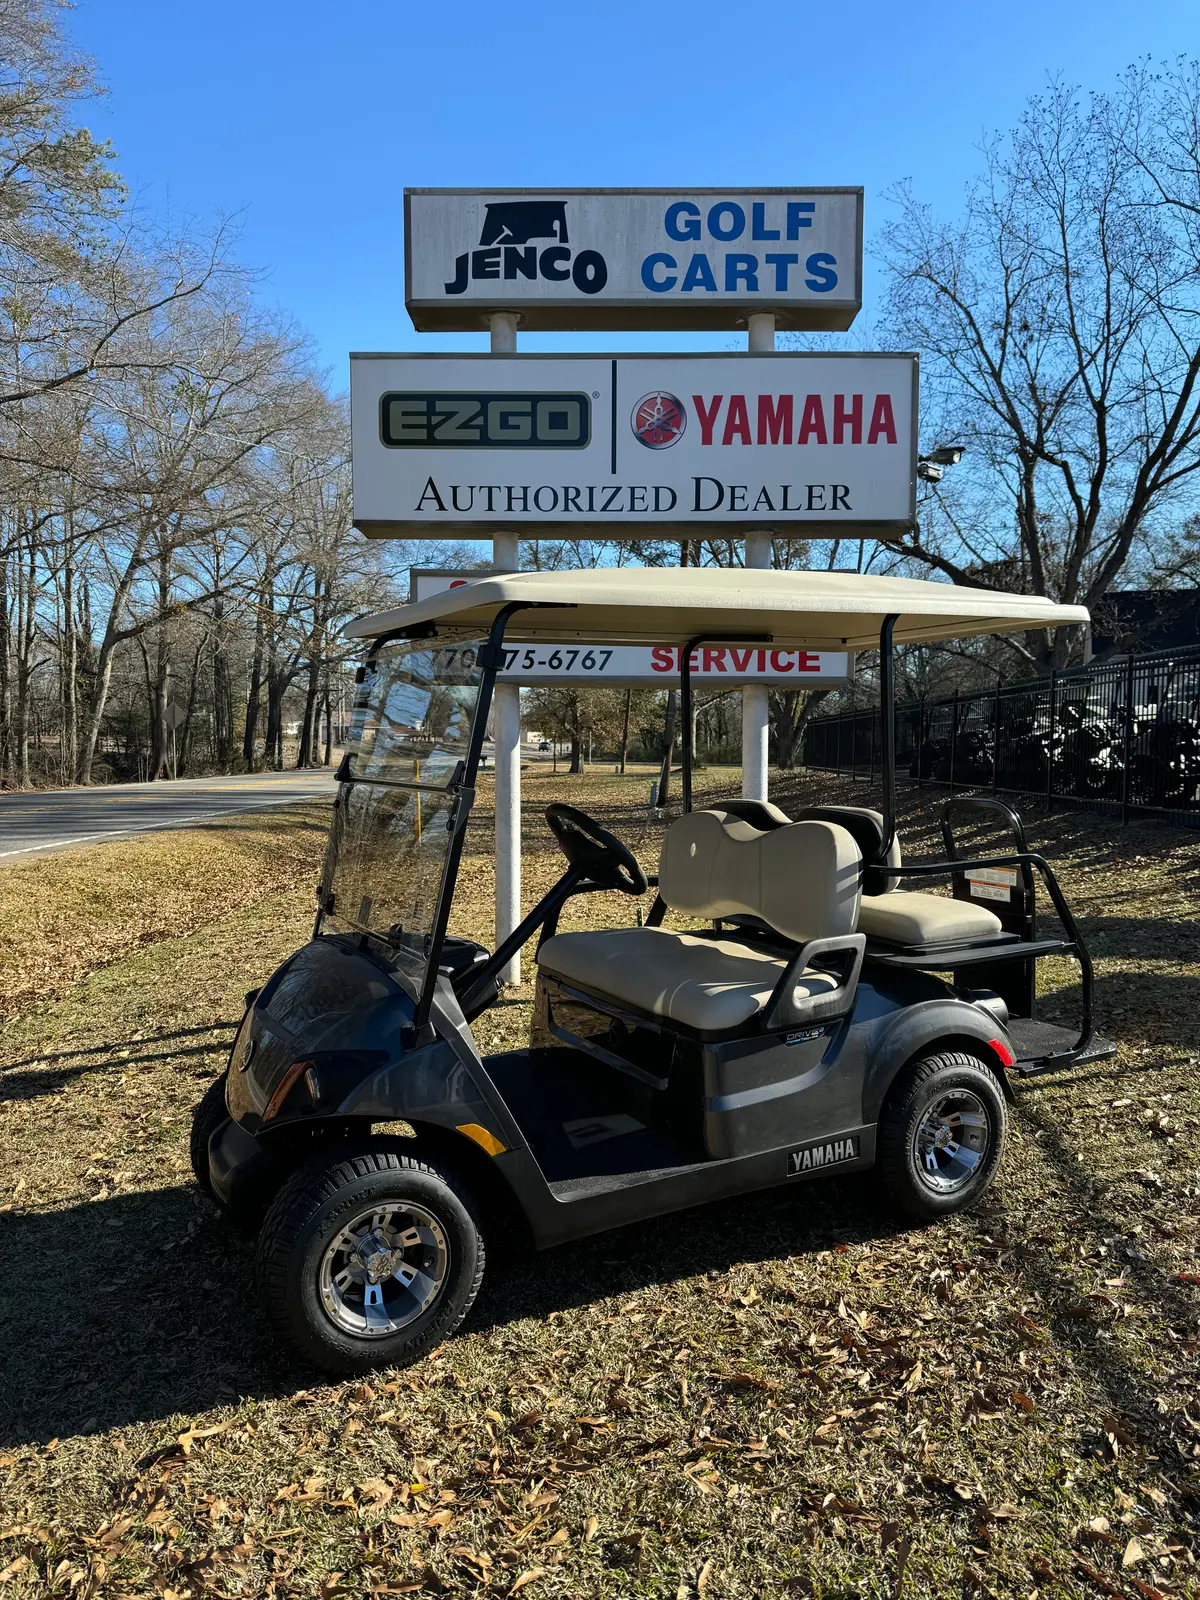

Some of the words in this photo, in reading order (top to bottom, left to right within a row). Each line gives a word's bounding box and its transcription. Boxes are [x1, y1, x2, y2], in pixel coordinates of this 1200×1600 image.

[664, 202, 815, 242] GOLF
[445, 246, 607, 294] JENCO
[641, 252, 838, 293] CARTS
[693, 395, 898, 446] YAMAHA
[651, 647, 821, 672] SERVICE
[792, 1138, 855, 1172] YAMAHA
